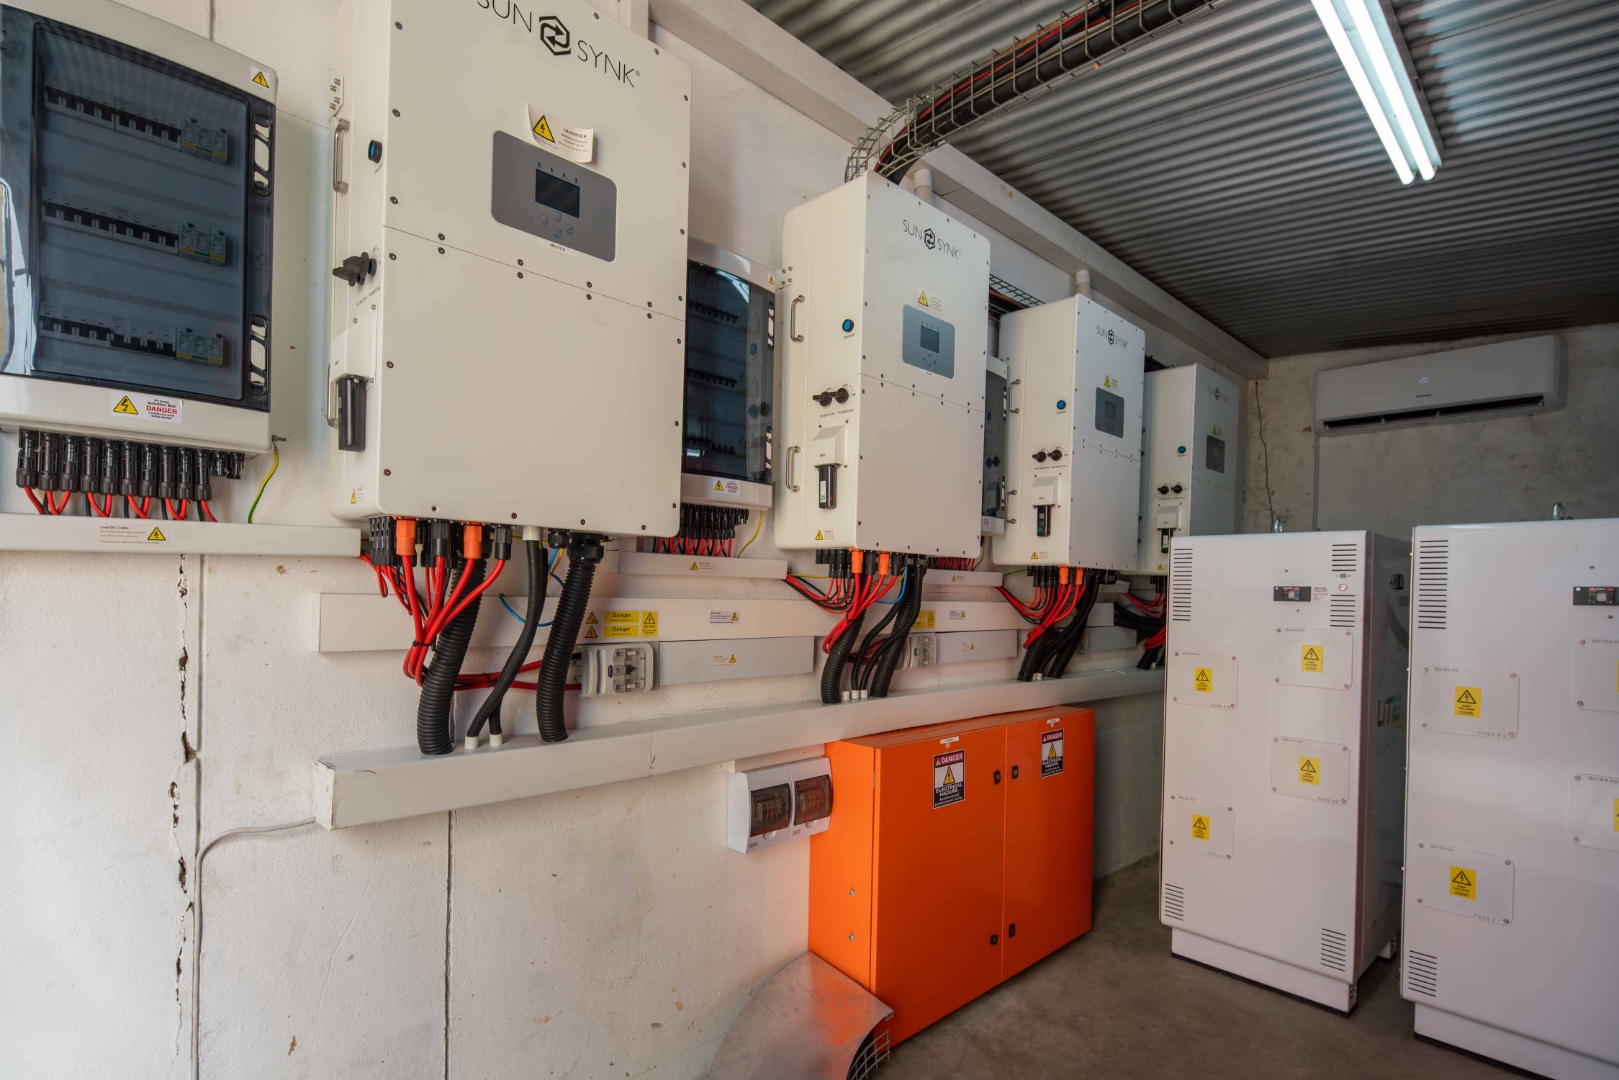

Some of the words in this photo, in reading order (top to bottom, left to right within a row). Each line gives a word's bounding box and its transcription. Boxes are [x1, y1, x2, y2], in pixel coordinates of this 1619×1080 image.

[903, 220, 922, 240] SUN
[146, 405, 178, 414] DANGER
[1046, 732, 1062, 740] DANGER
[942, 752, 963, 764] DANGER
[936, 782, 962, 793] ELECTRICAL
